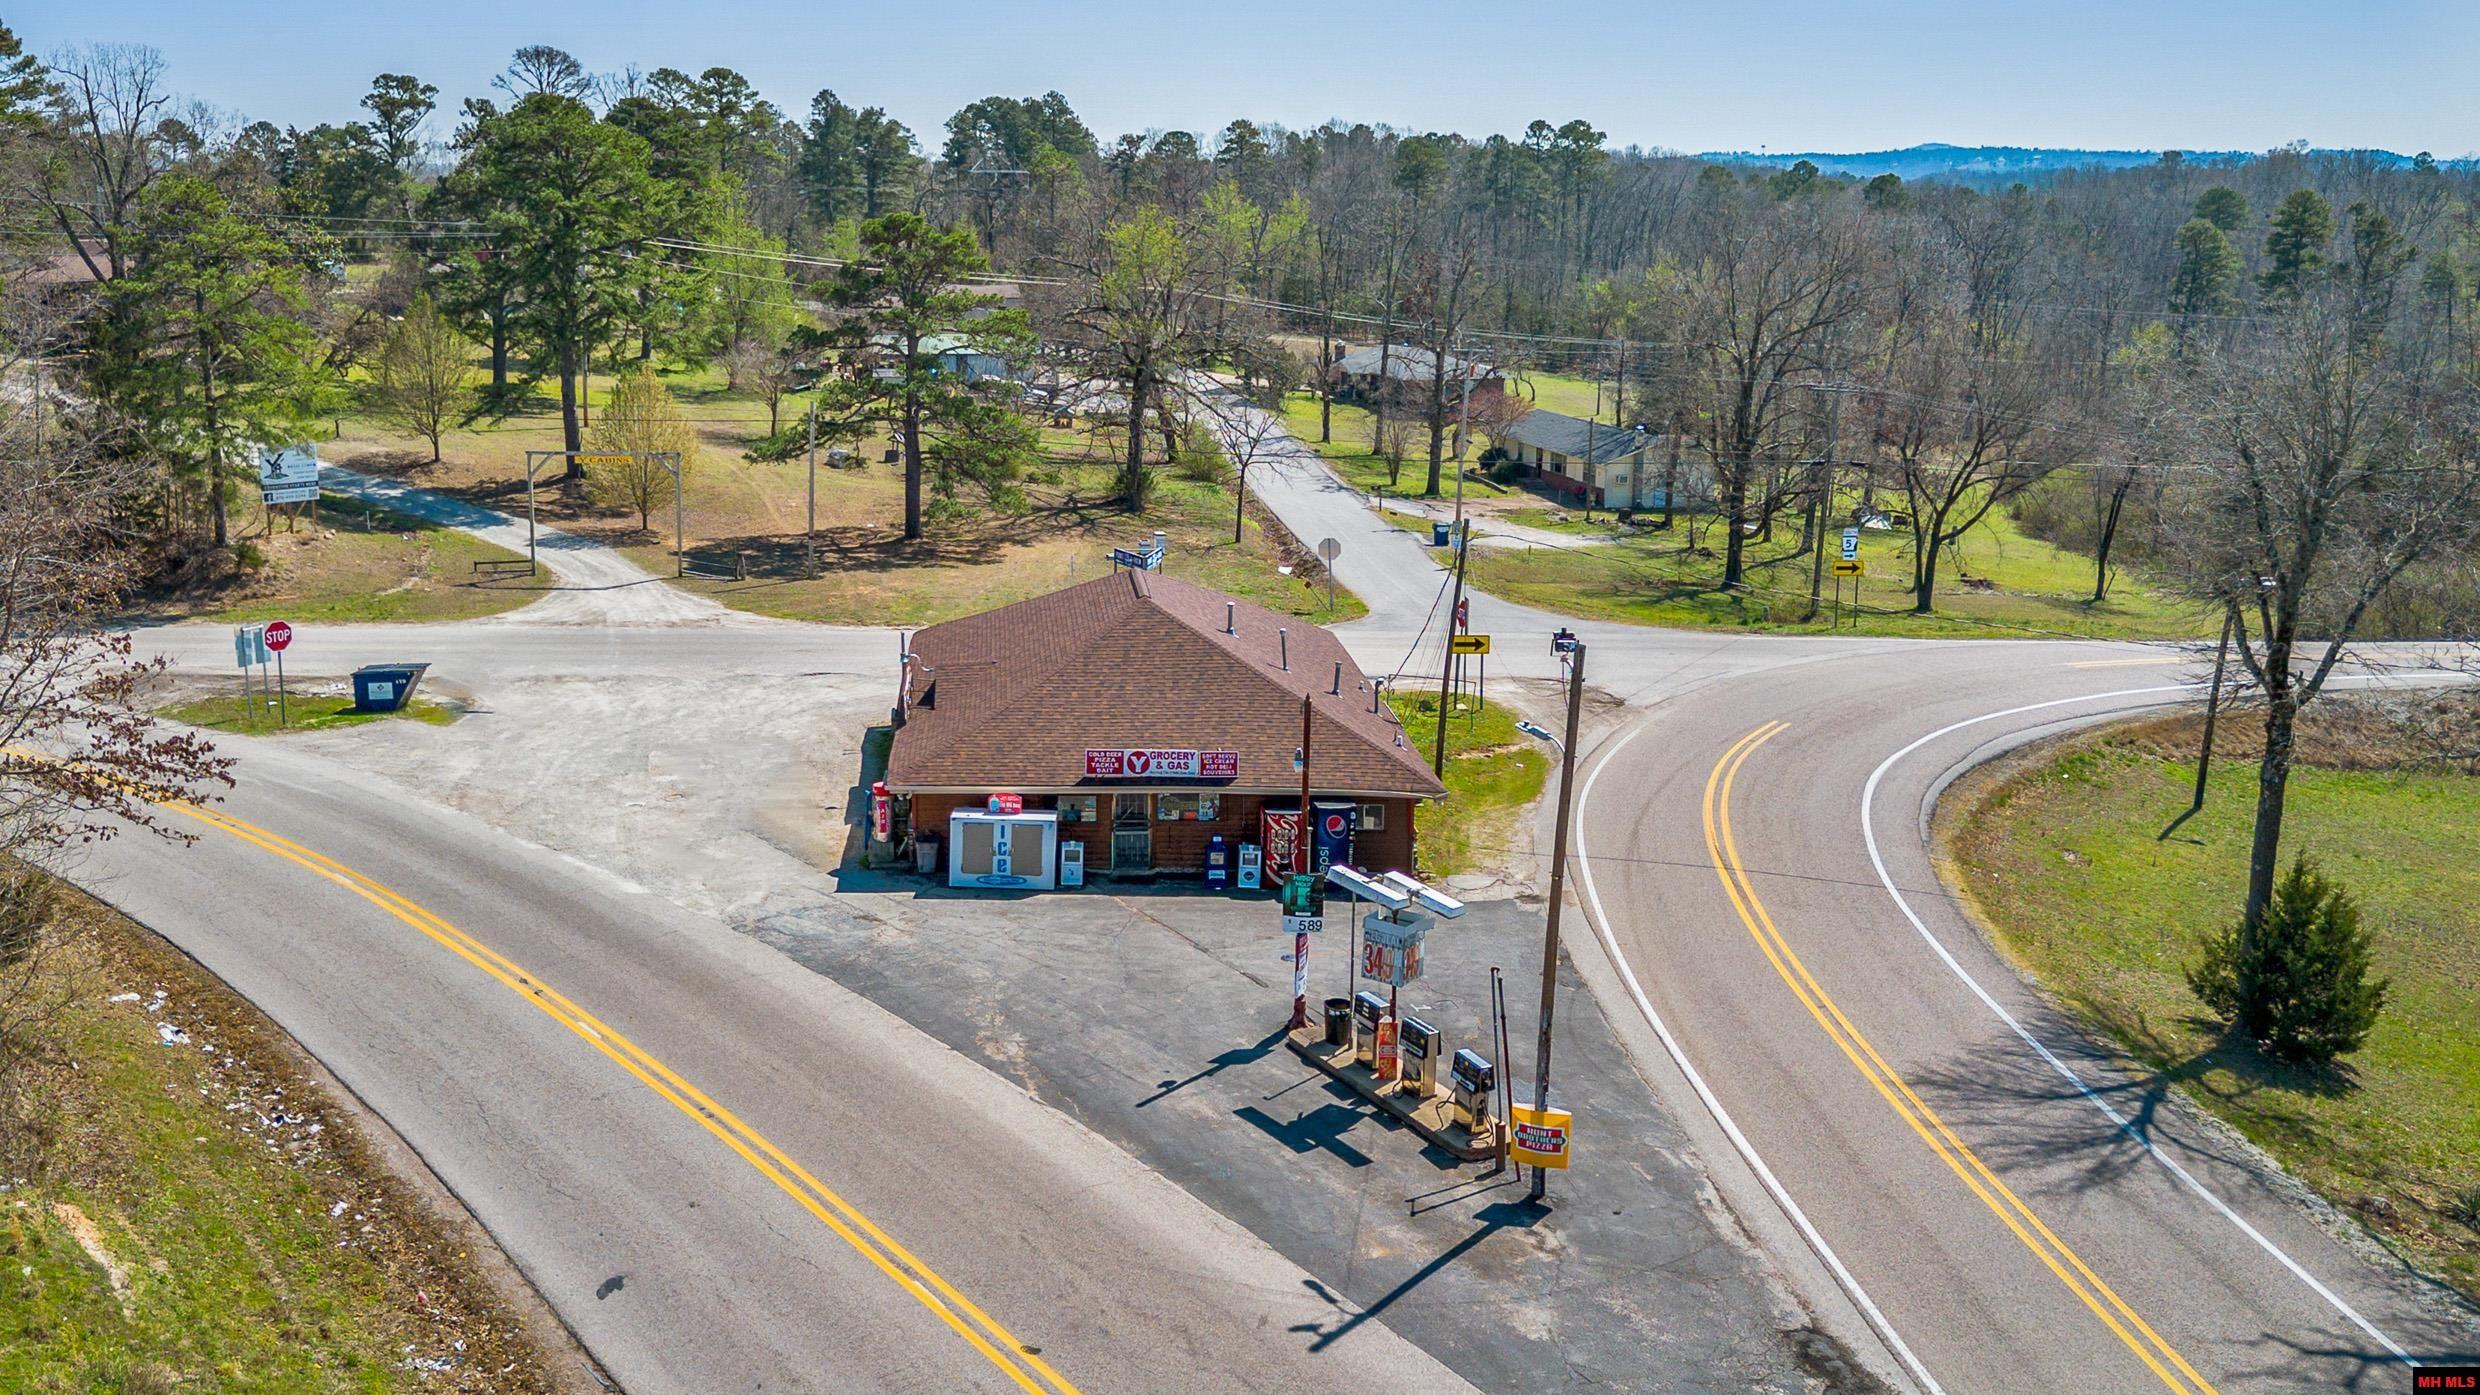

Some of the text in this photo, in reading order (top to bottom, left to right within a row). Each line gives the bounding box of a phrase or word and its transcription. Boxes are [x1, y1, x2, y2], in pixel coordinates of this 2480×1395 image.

[266, 629, 291, 644] STOP
[1150, 751, 1196, 760] GROCERY
[1130, 756, 1147, 773] Y
[1156, 761, 1190, 770] & GAS
[1319, 846, 1331, 874] epsi
[1298, 920, 1323, 931] 589
[1525, 1140, 1553, 1151] PIZZA
